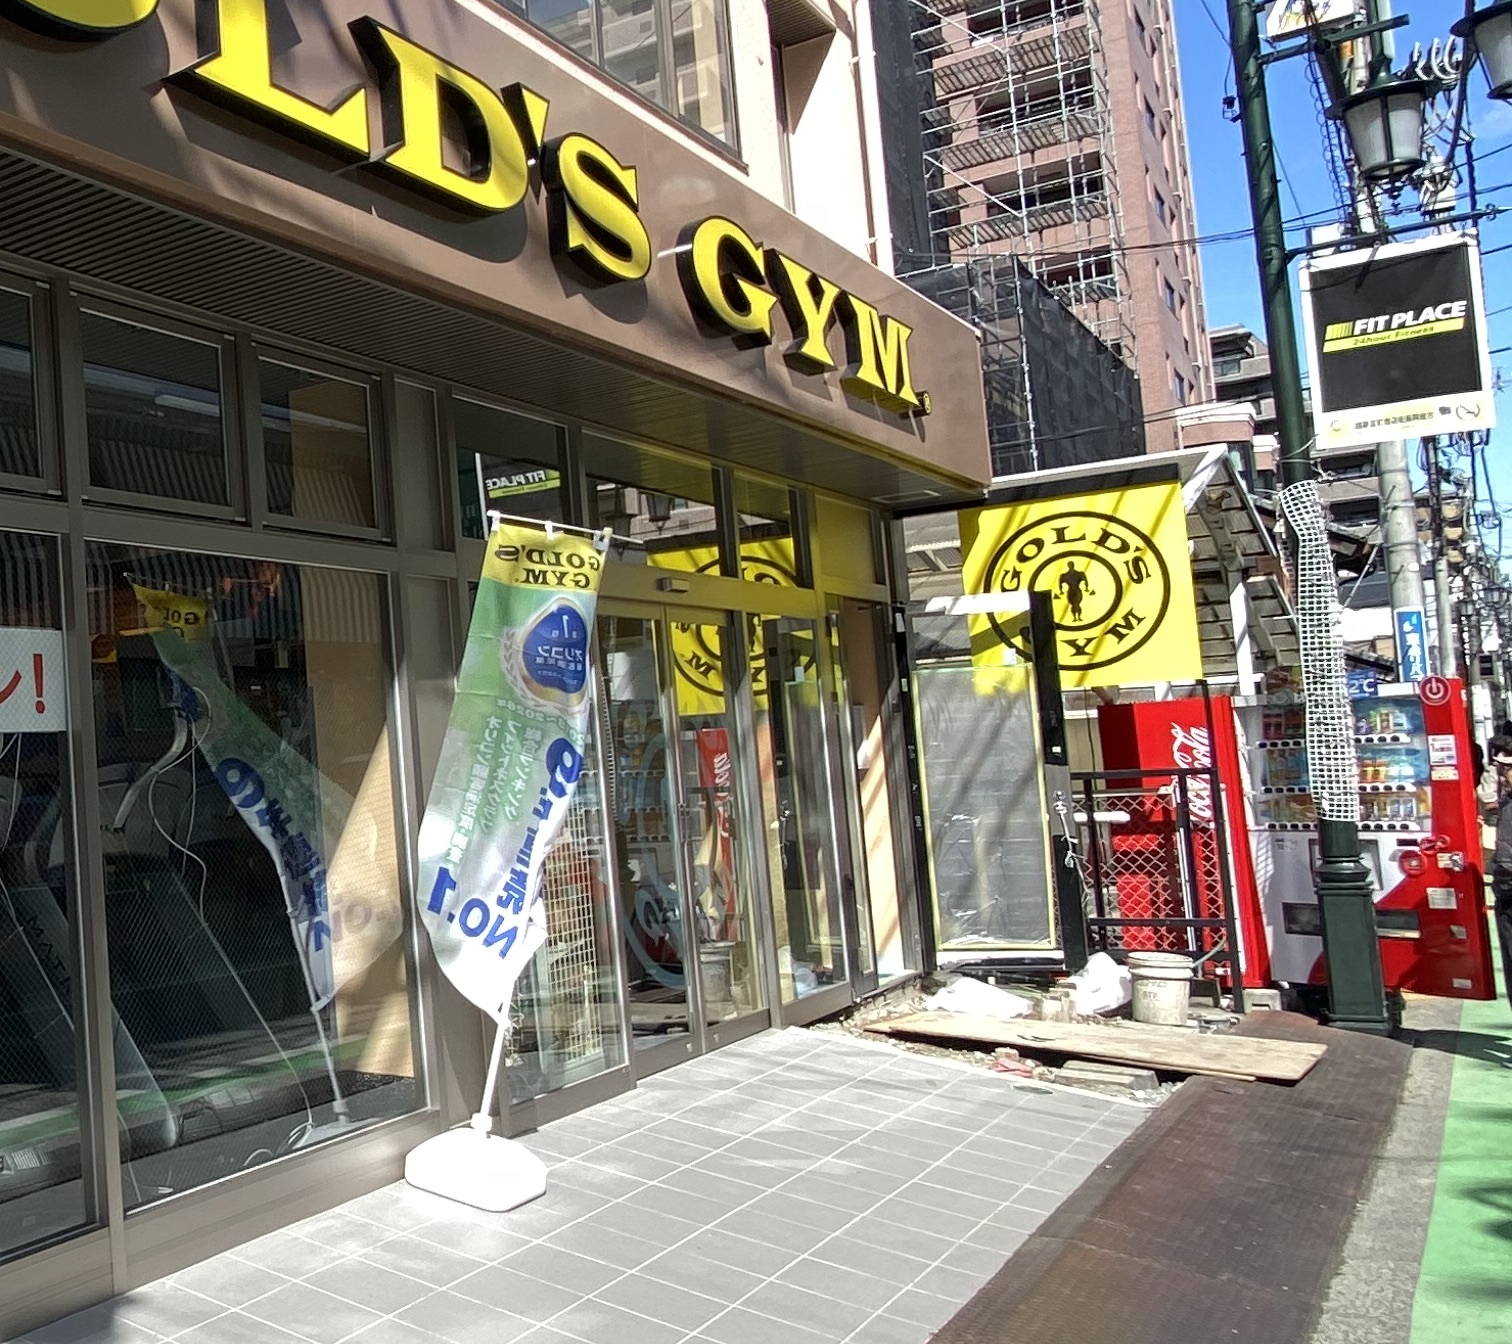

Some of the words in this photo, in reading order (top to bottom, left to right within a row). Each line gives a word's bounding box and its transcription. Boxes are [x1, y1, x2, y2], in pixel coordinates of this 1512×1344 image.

[1353, 314, 1390, 336] FIT
[1390, 300, 1468, 329] PLACE
[1000, 525, 1151, 593] GOLD'S
